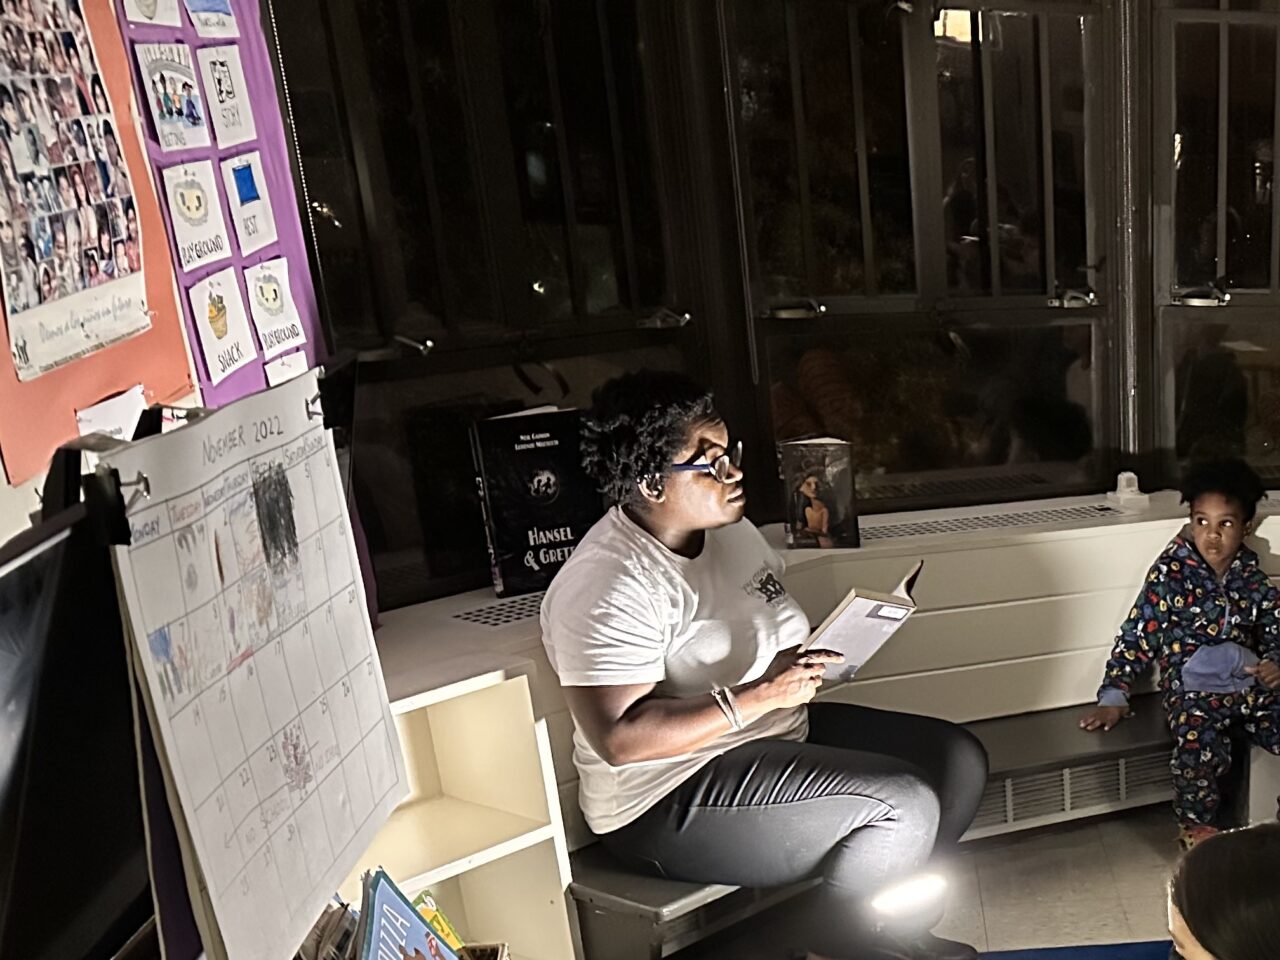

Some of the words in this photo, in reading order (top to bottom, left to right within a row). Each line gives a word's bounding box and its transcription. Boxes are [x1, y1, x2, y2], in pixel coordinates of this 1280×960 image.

[243, 215, 258, 236] REST
[217, 342, 243, 373] SNACK
[202, 425, 246, 466] NOVEMBER
[252, 415, 284, 443] 2022
[528, 526, 575, 546] HANSEL
[524, 550, 540, 571] &
[539, 546, 576, 564] GRET
